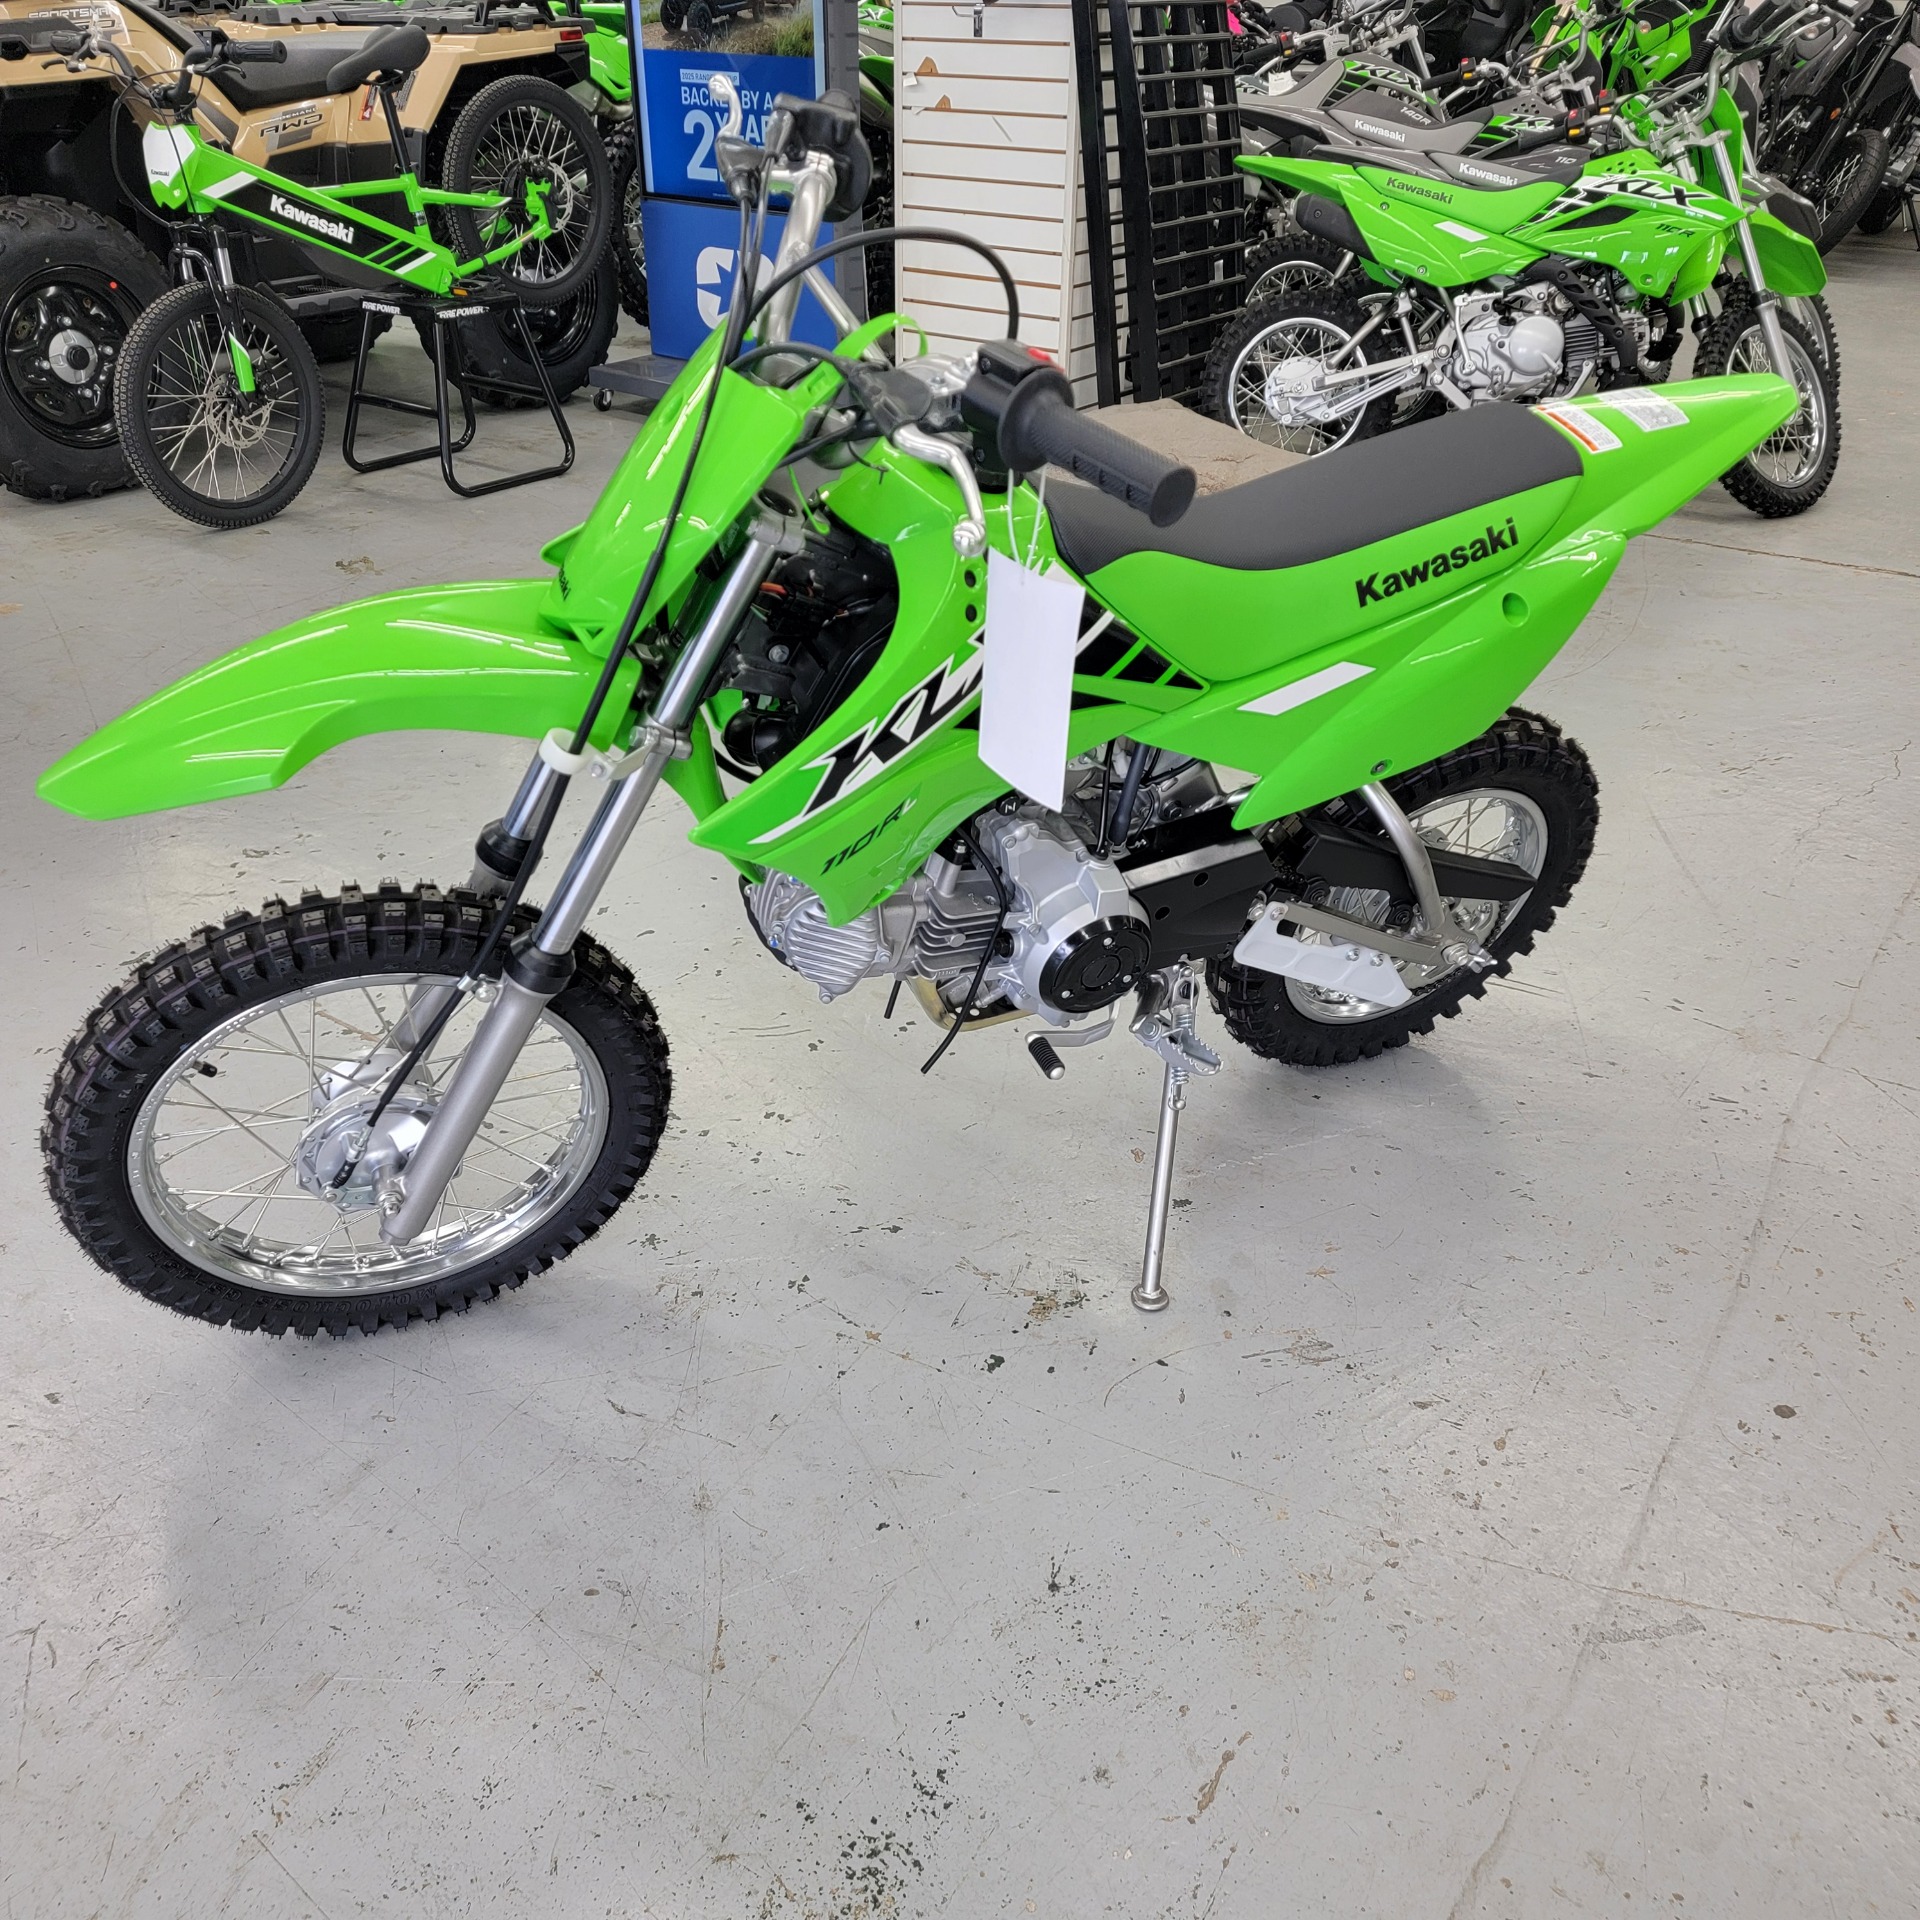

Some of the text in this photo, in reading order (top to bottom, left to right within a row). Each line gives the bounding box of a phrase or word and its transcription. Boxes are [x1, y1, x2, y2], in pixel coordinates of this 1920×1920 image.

[681, 86, 774, 111] BACK BY A
[260, 113, 323, 138] AWD
[1399, 106, 1432, 126] 140R
[683, 109, 719, 182] 2
[1354, 119, 1406, 143] Kawasaki
[1459, 162, 1519, 187] Kawasaki
[1386, 176, 1454, 205] Kawasaki
[1590, 177, 1716, 208] KLX
[269, 193, 355, 245] Kawasaki
[1354, 516, 1520, 609] Kawasaki
[797, 622, 989, 820] KL
